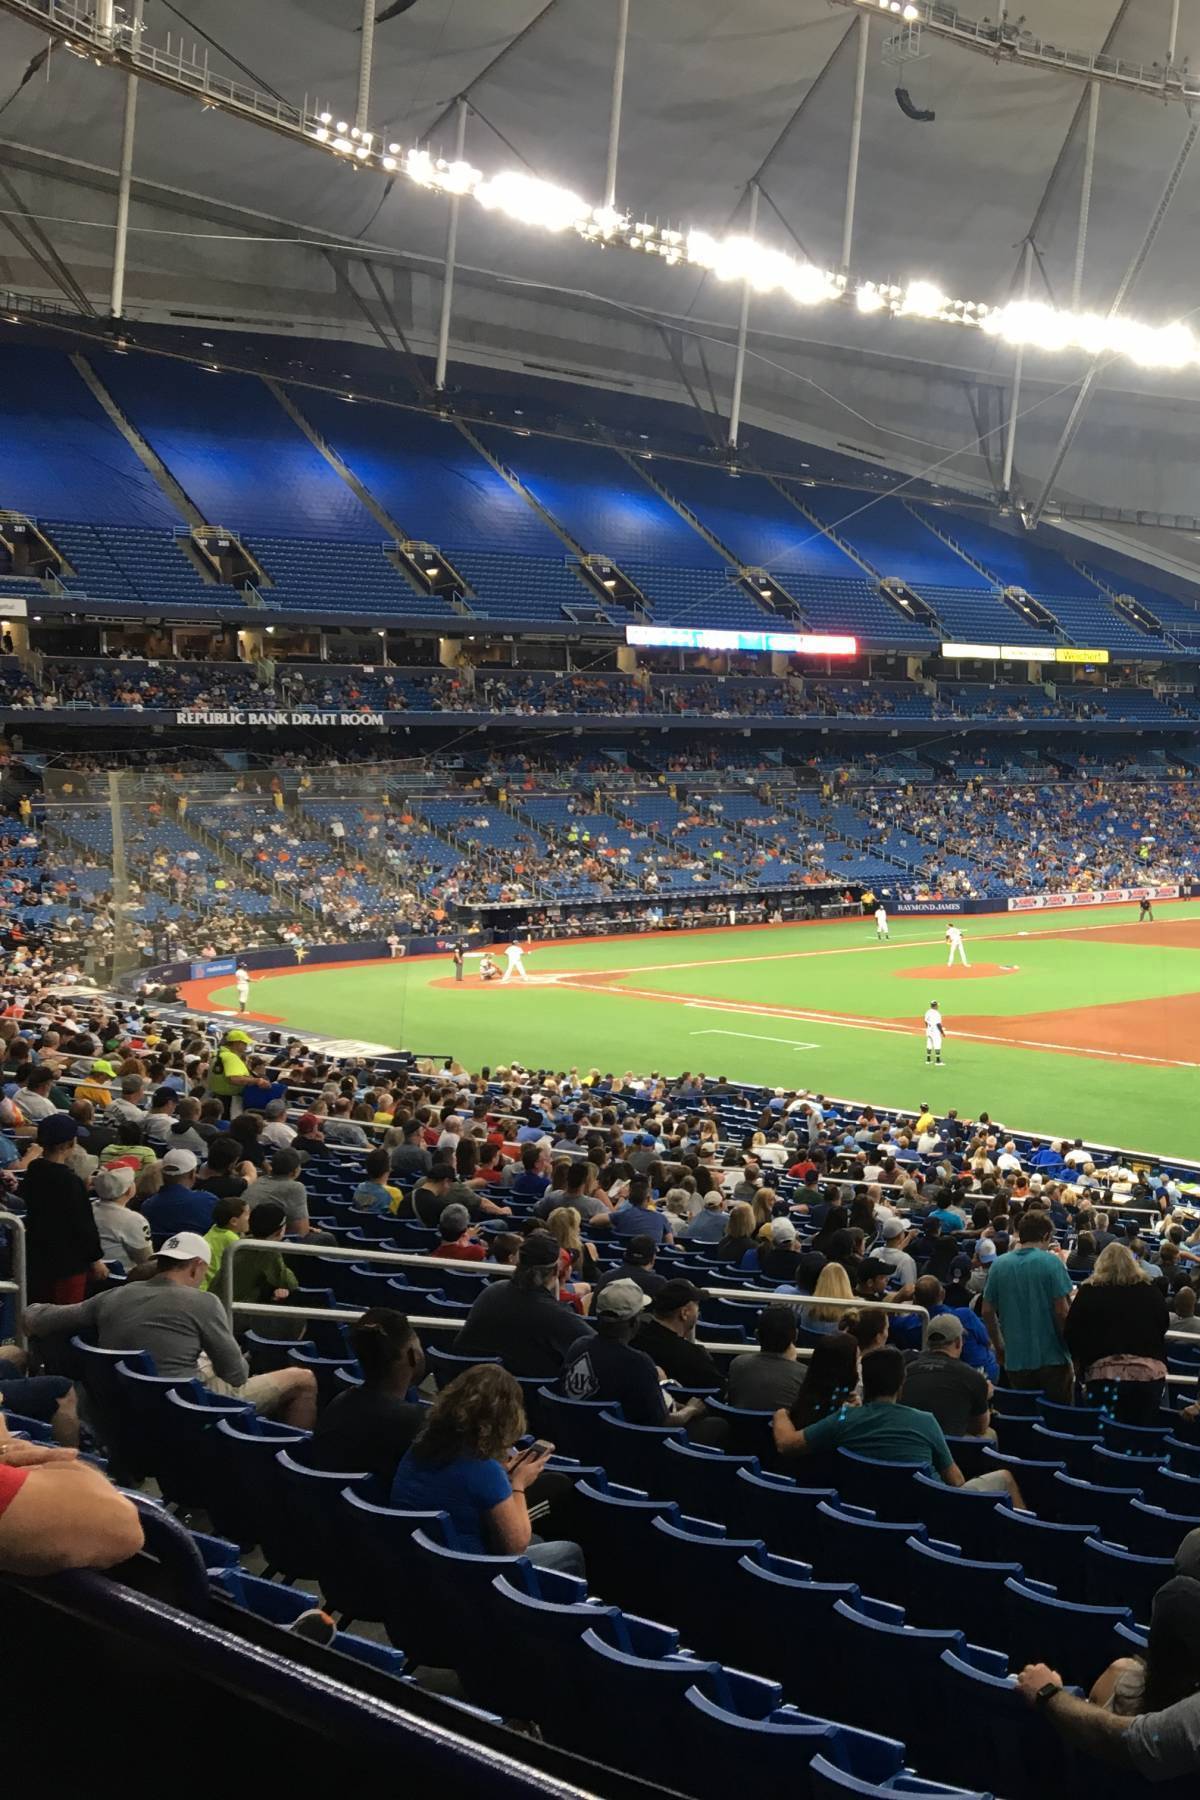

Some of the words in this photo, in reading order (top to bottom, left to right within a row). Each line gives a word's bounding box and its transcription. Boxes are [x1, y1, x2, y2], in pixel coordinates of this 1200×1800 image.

[176, 712, 247, 725] REPUBLIC
[248, 713, 289, 725] BANK
[292, 713, 336, 725] DRAFT
[340, 714, 384, 725] ROOM
